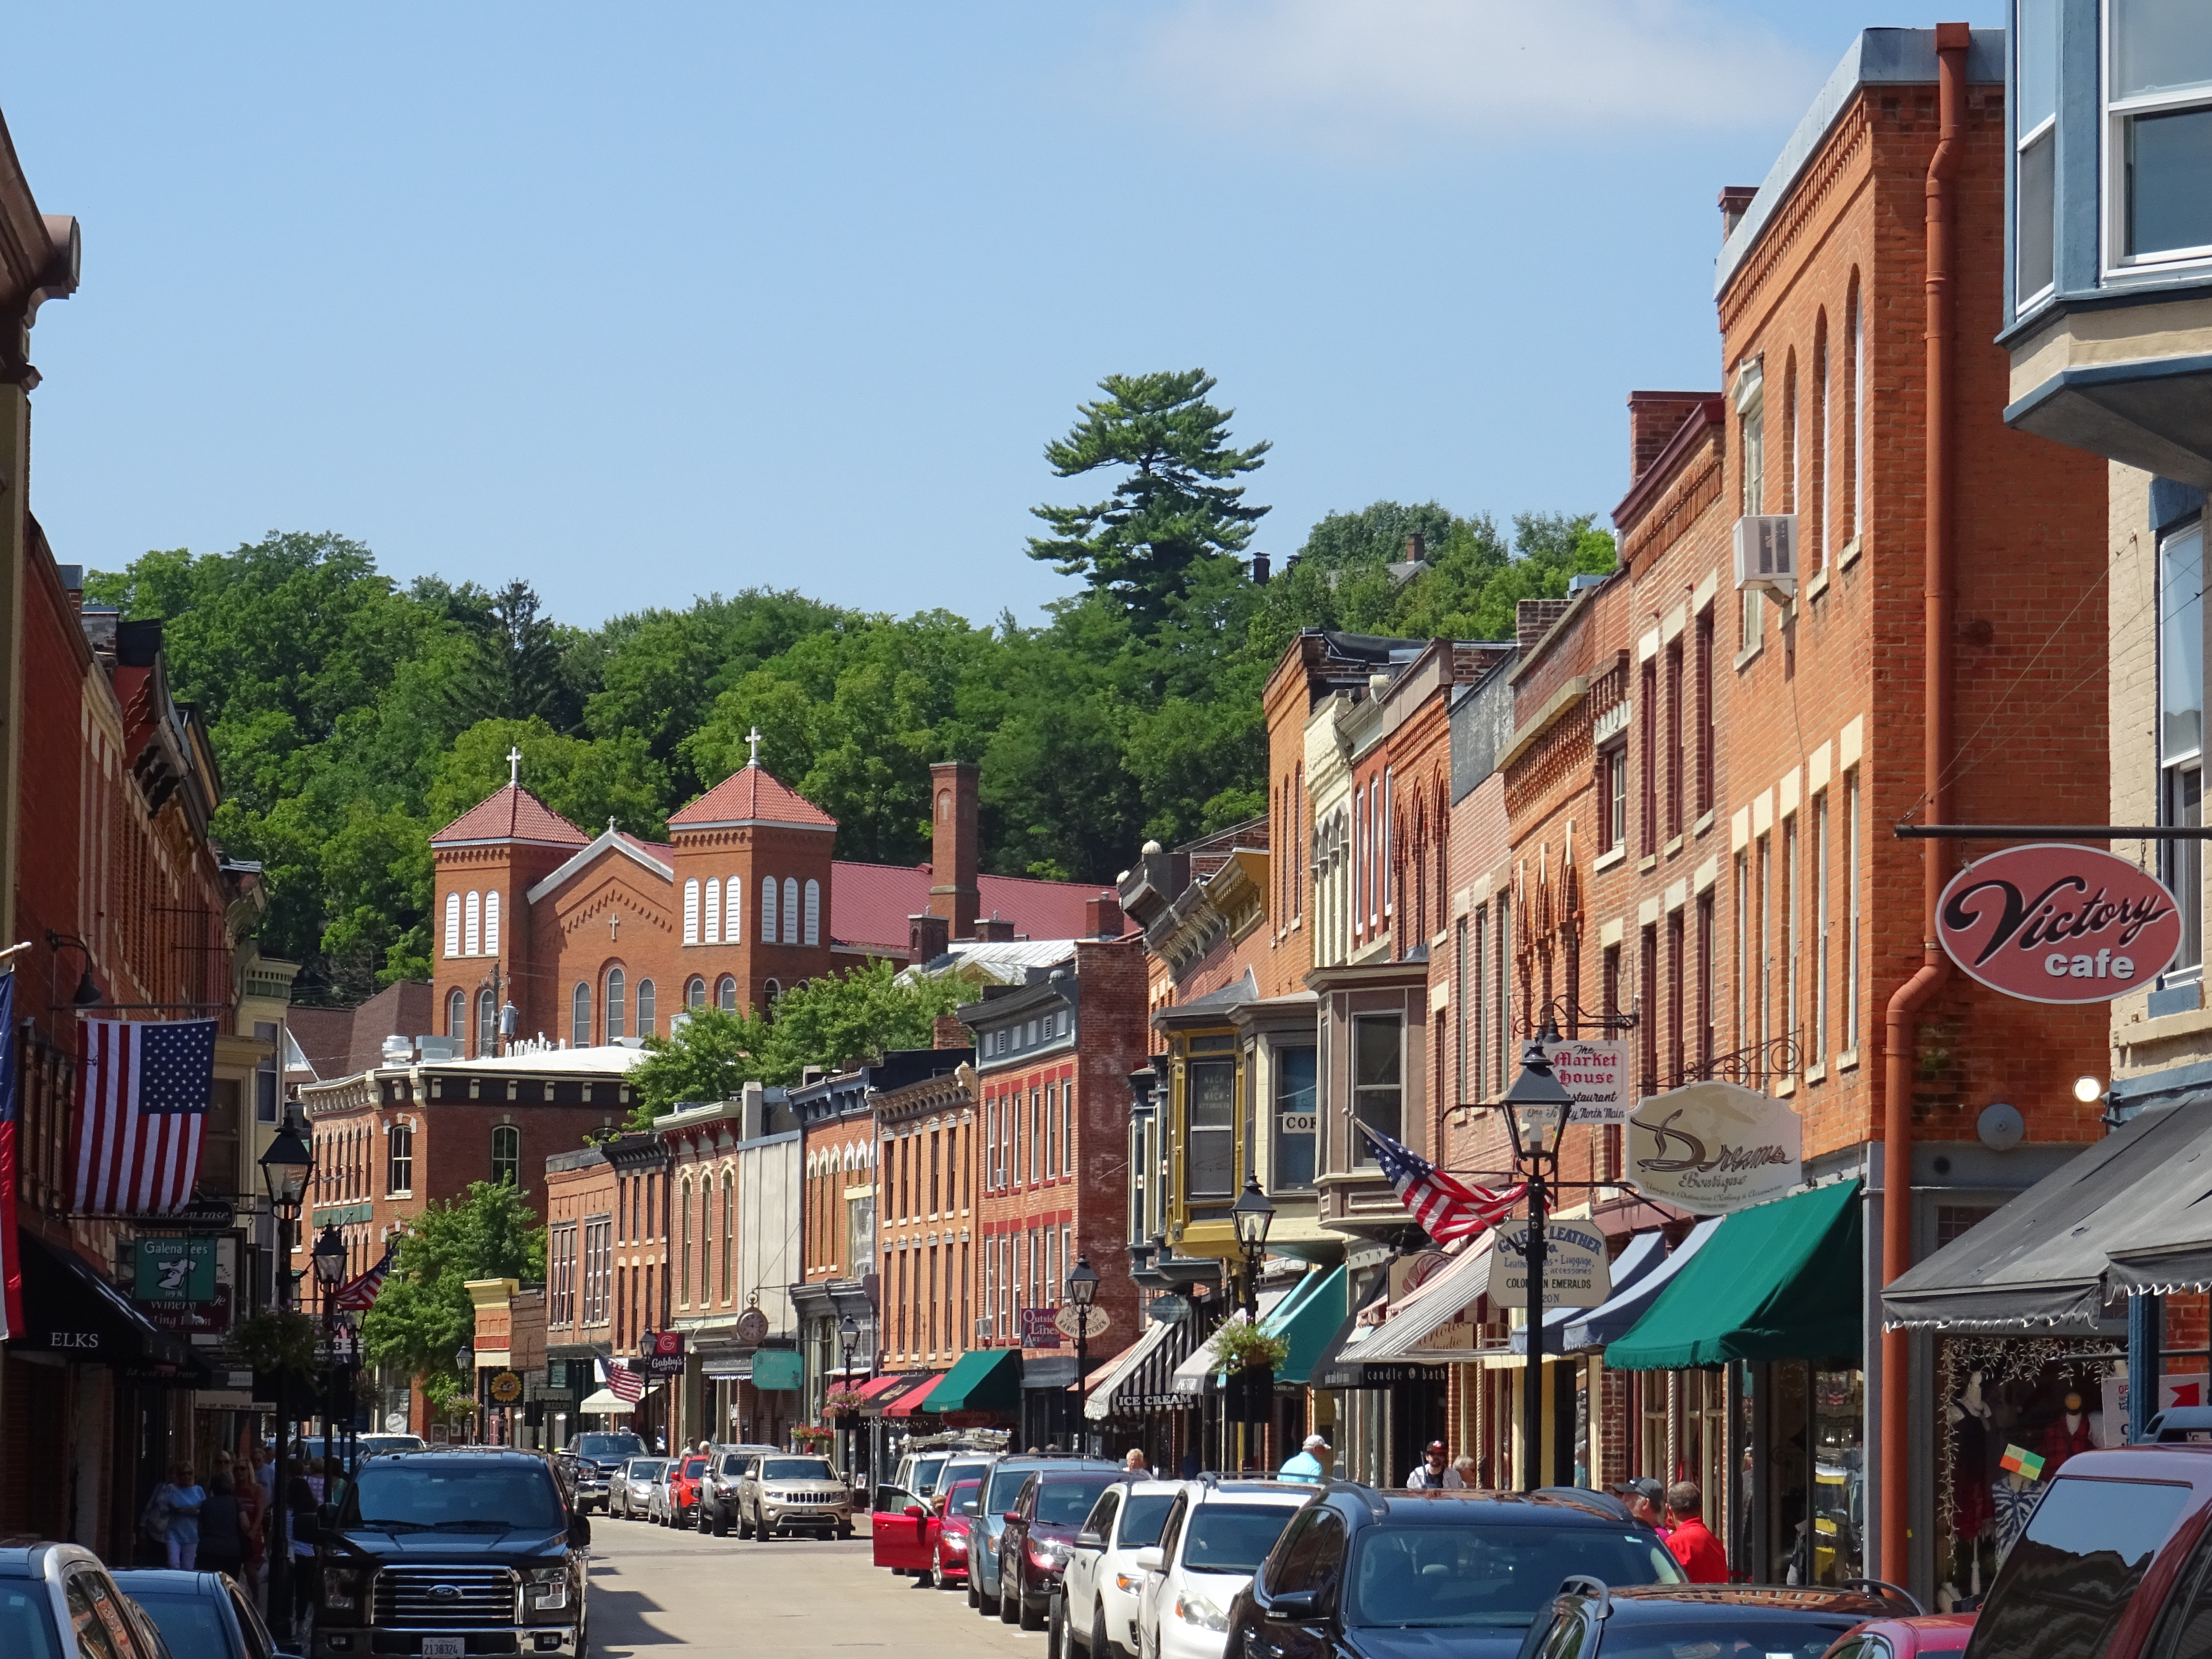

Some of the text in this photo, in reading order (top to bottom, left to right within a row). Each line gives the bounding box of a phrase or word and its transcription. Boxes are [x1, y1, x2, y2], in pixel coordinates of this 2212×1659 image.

[1944, 876, 2175, 968] Victory
[2044, 948, 2135, 979] cafe
[1573, 1045, 1595, 1054] The
[1553, 1051, 1618, 1068] Market
[1567, 1091, 1618, 1102] staurant
[1580, 1108, 1603, 1118] North
[1604, 1108, 1625, 1118] Main
[1630, 1109, 1796, 1173] Dreams
[1678, 1171, 1747, 1193] Boutique
[145, 1240, 183, 1254] Galena
[1548, 1225, 1602, 1256] LEATHER
[1504, 1257, 1528, 1268] Leathe
[1560, 1254, 1595, 1268] Luggage,
[1550, 1267, 1592, 1275] accessories
[1552, 1278, 1592, 1289] EMERALDS
[1023, 1309, 1057, 1322] Outsid
[1029, 1322, 1059, 1335] Lines
[1087, 1319, 1108, 1335] TCHEN
[50, 1332, 99, 1348] ELKS
[660, 1335, 675, 1350] G
[651, 1356, 683, 1371] Gabby's
[1367, 1367, 1445, 1380] candle bath
[1119, 1394, 1193, 1406] ICE CREAM
